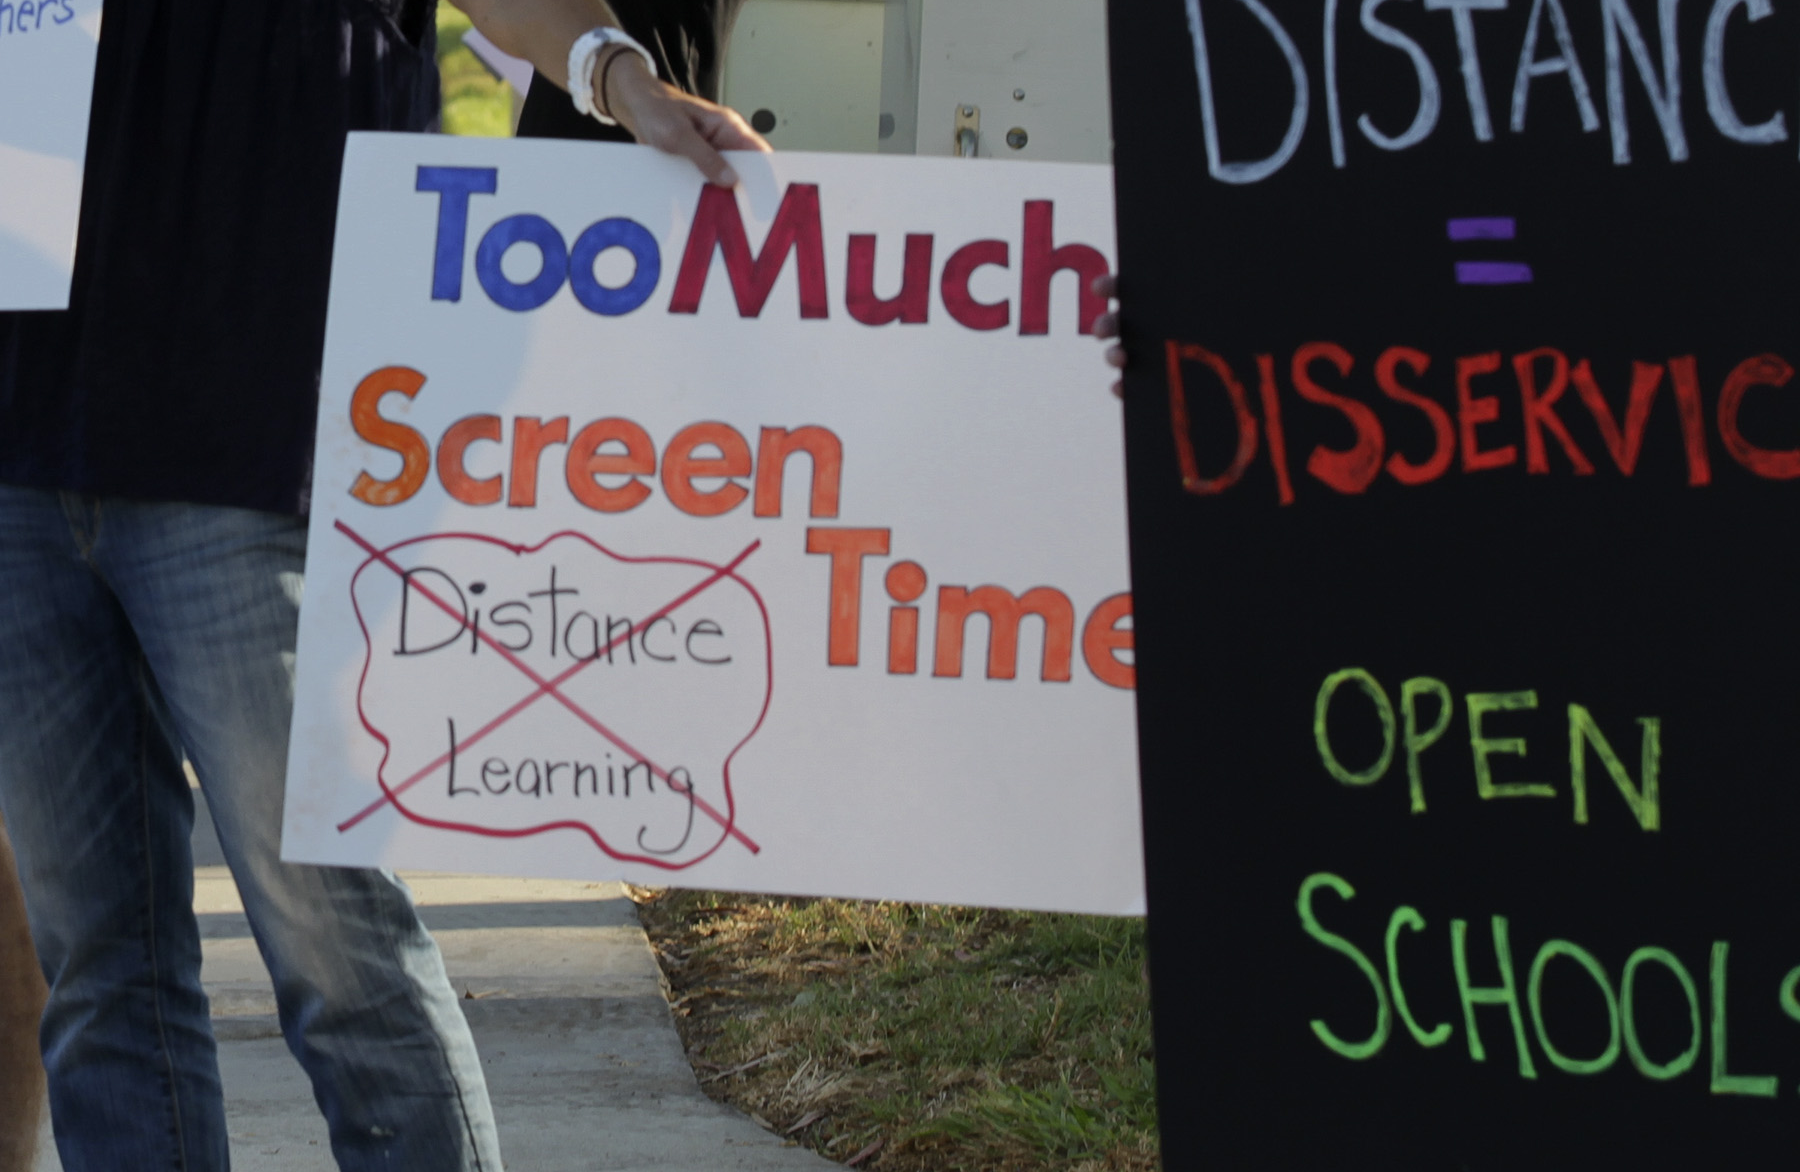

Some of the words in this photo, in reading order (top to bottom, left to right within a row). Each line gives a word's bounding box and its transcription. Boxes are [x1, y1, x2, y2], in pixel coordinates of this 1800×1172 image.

[414, 164, 663, 318] Too
[667, 181, 1111, 338] Much
[347, 364, 845, 519] Screen
[1163, 338, 1800, 507] DISSERVIC
[392, 565, 734, 667] Distance
[805, 526, 1137, 691] Time
[445, 717, 696, 855] Learning
[1313, 666, 1662, 832] OPEN
